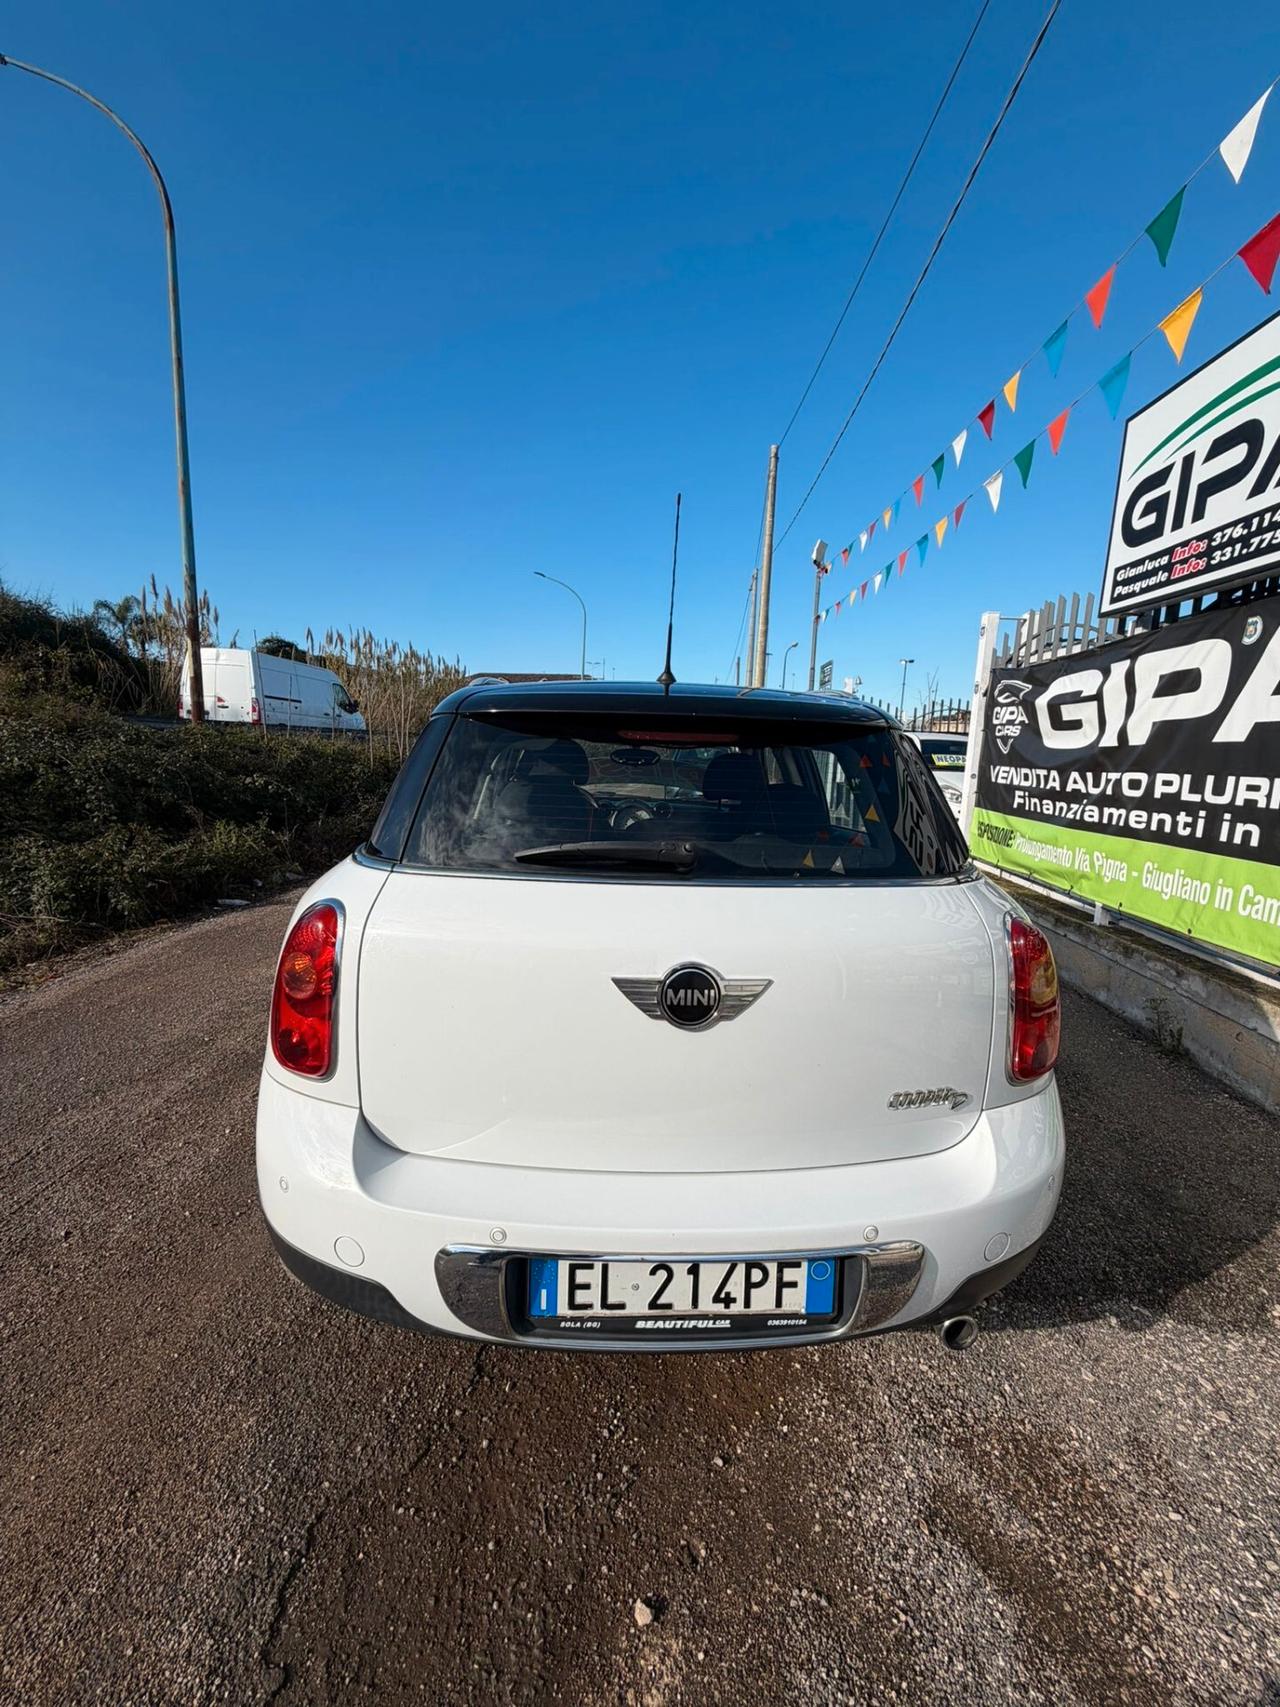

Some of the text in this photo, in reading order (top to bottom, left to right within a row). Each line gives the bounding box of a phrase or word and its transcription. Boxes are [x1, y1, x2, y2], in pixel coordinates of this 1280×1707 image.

[1113, 529, 1280, 598] Pasquale Info: 331.775
[1116, 554, 1169, 581] Gianluca
[1171, 538, 1208, 562] Info:
[992, 705, 1029, 725] GIPA
[995, 725, 1021, 737] CRS
[990, 765, 1061, 791] VENDITA
[1065, 771, 1149, 798] AUTO
[1013, 790, 1261, 847] Finanziamenti in
[1014, 832, 1073, 868] Prolungamento
[1074, 847, 1091, 873] Via
[1093, 850, 1128, 883] Pigna
[1142, 861, 1211, 905] Giugliano
[1214, 878, 1234, 912] in
[666, 988, 716, 1007] MINI
[567, 1262, 627, 1311] EL
[647, 1260, 802, 1311] 214PF
[635, 1320, 715, 1329] BEAUTIFUL
